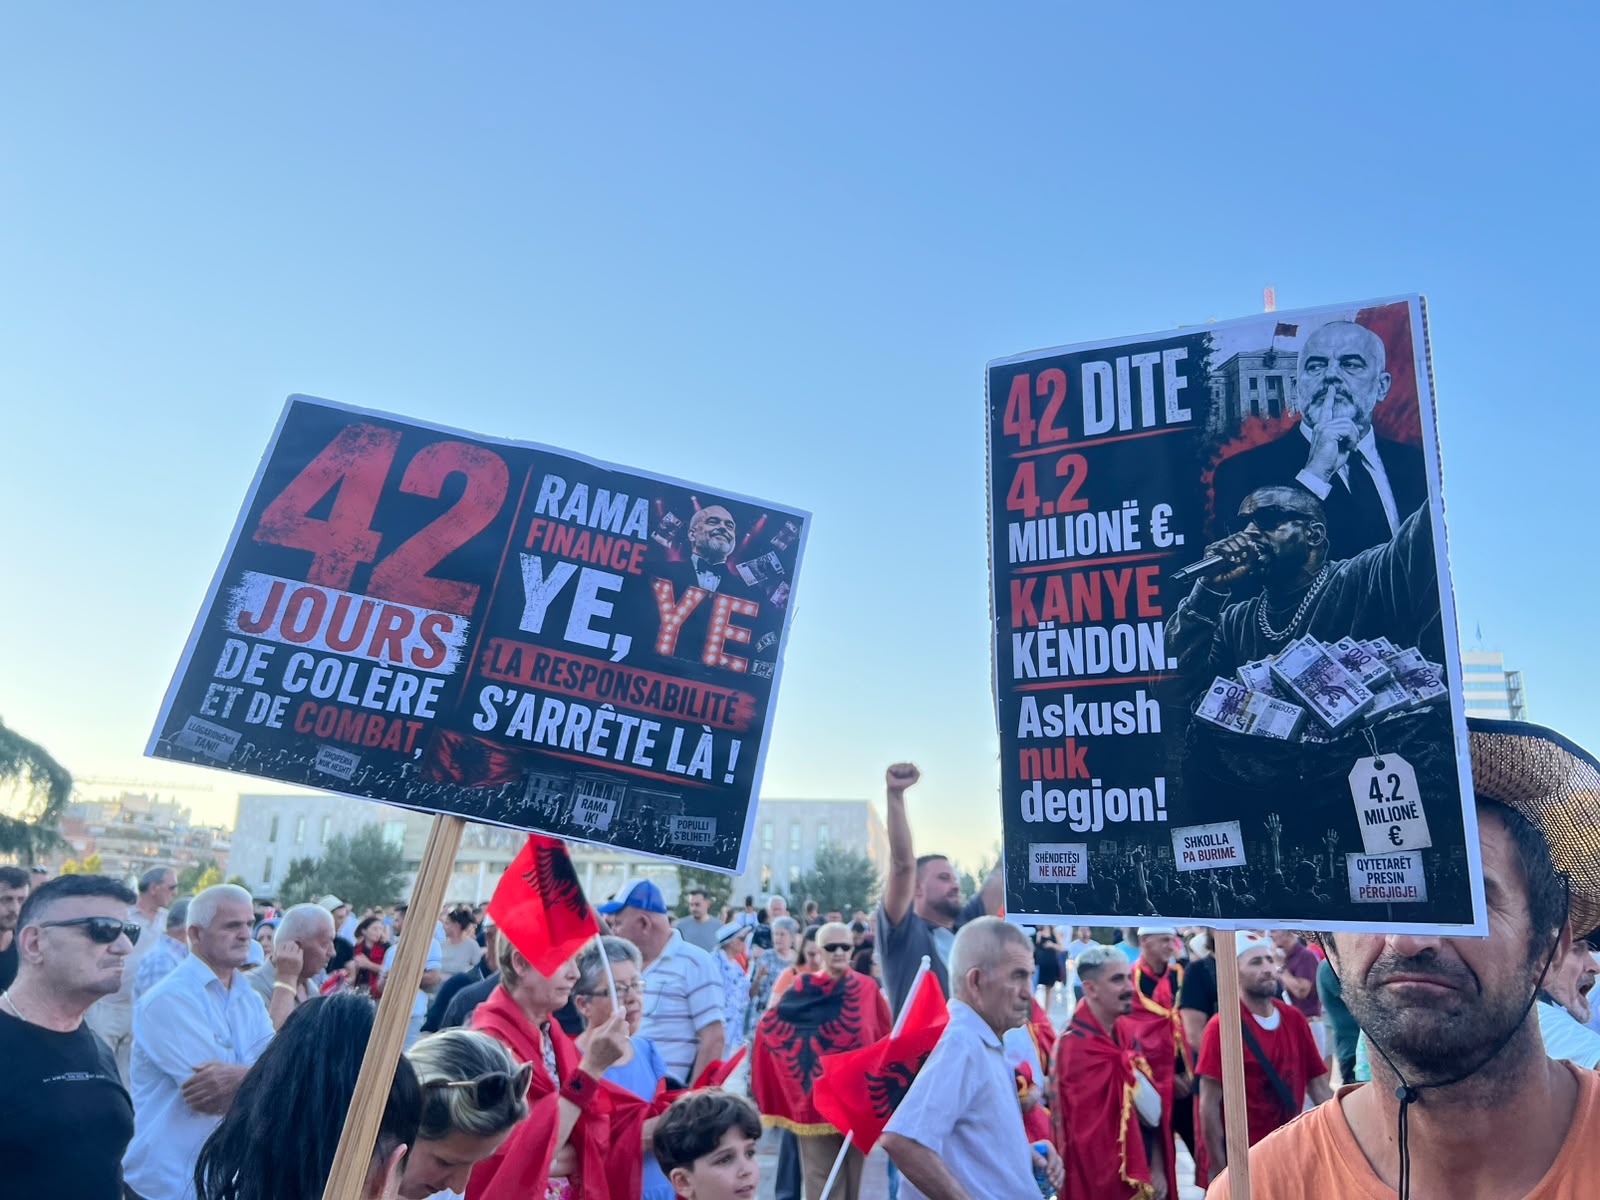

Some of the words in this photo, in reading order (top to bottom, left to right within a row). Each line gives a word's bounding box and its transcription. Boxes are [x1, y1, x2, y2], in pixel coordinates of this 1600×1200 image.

[1003, 368, 1068, 447] 42
[1081, 347, 1192, 437] DITE
[534, 473, 649, 541] RAMA
[1006, 453, 1089, 518] 4.2
[253, 422, 510, 616] 42
[1008, 500, 1141, 563] MILIONË
[1150, 503, 1185, 548] €.
[525, 518, 648, 574] FINANCE
[519, 552, 632, 663] YE,
[653, 577, 760, 673] YE
[1010, 565, 1163, 628] KANYE
[237, 580, 454, 670] JOURS
[1012, 621, 1178, 679] KËNDON.
[213, 638, 276, 686] DE
[281, 652, 445, 719] COLÈRE
[489, 642, 521, 678] LA
[530, 653, 741, 726] RESPONSABILITÉ
[200, 683, 244, 719] ET
[245, 691, 291, 729] DE
[294, 701, 423, 760] COMBAT,
[472, 685, 661, 768] S'ARRÊTE
[666, 725, 714, 780] LÀ
[1017, 690, 1162, 739] Askush
[1019, 737, 1091, 780] nuk
[580, 798, 609, 814] RAMA
[1020, 776, 1168, 833] degjon!
[1364, 800, 1420, 826] MILIONË
[1369, 773, 1405, 803] 4.2
[583, 811, 599, 825] IK!
[677, 819, 710, 830] POPULLI
[1184, 833, 1230, 849] SHKOLLA
[1388, 825, 1404, 846] €
[1034, 852, 1081, 865] SHËNDETËSI
[1038, 863, 1051, 877] NË
[1051, 863, 1077, 877] KRIZË
[1182, 850, 1196, 864] PA
[1197, 846, 1237, 862] BURIME
[1356, 856, 1412, 872] QYTETARËT
[1367, 872, 1405, 885] PRESIN
[1359, 884, 1418, 899] PËRGJIGJE!
